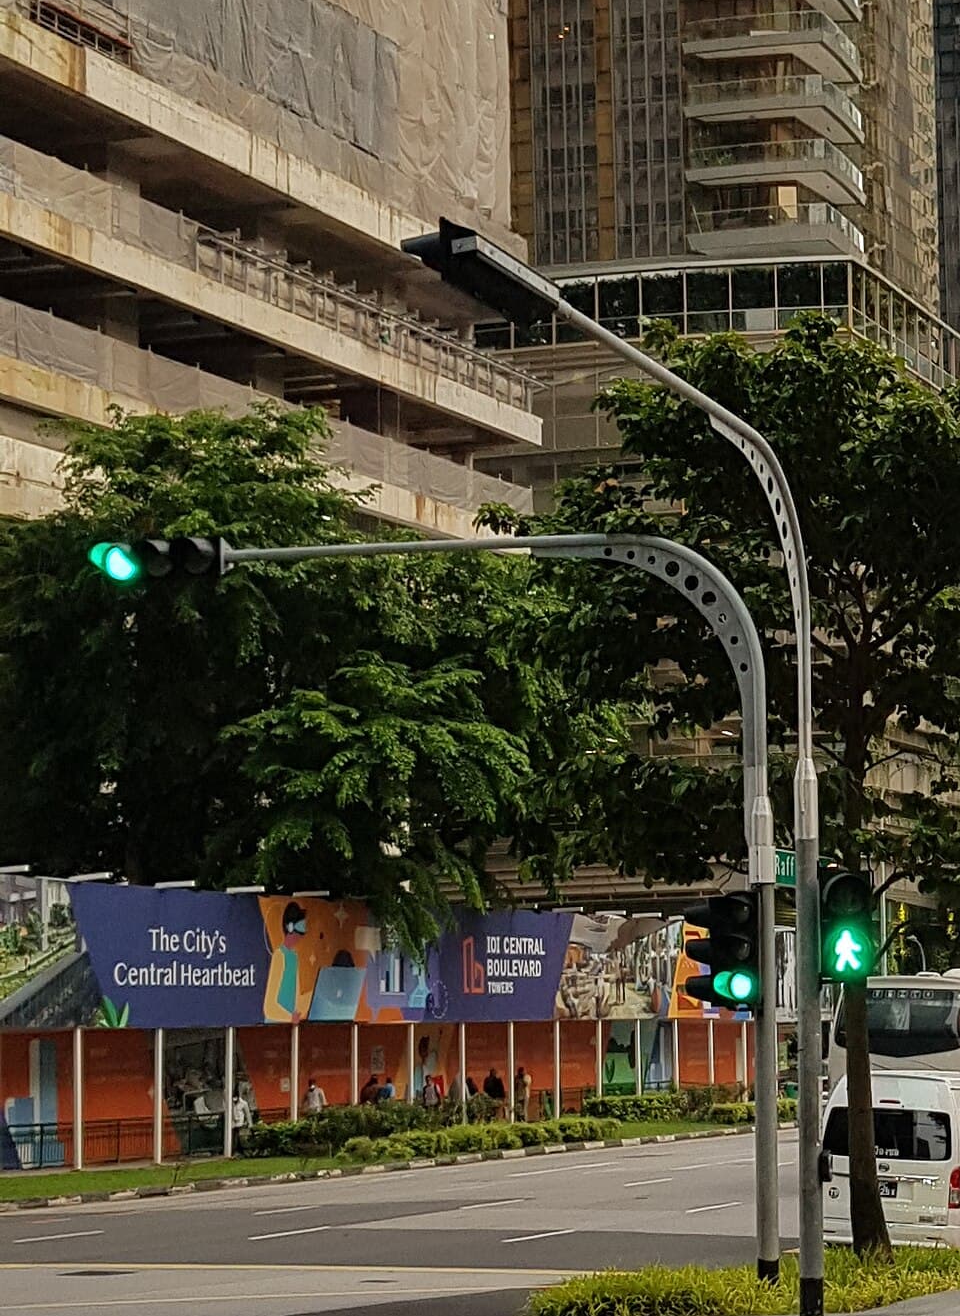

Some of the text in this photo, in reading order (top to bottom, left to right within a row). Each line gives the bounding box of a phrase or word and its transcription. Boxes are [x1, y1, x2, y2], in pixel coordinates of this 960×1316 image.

[775, 854, 797, 877] Raff
[148, 926, 227, 959] The City's
[503, 936, 546, 956] CENTRAL
[113, 961, 256, 987] Central Heartbeat
[486, 958, 542, 977] BOULEVARD
[487, 981, 514, 994] TOWERS
